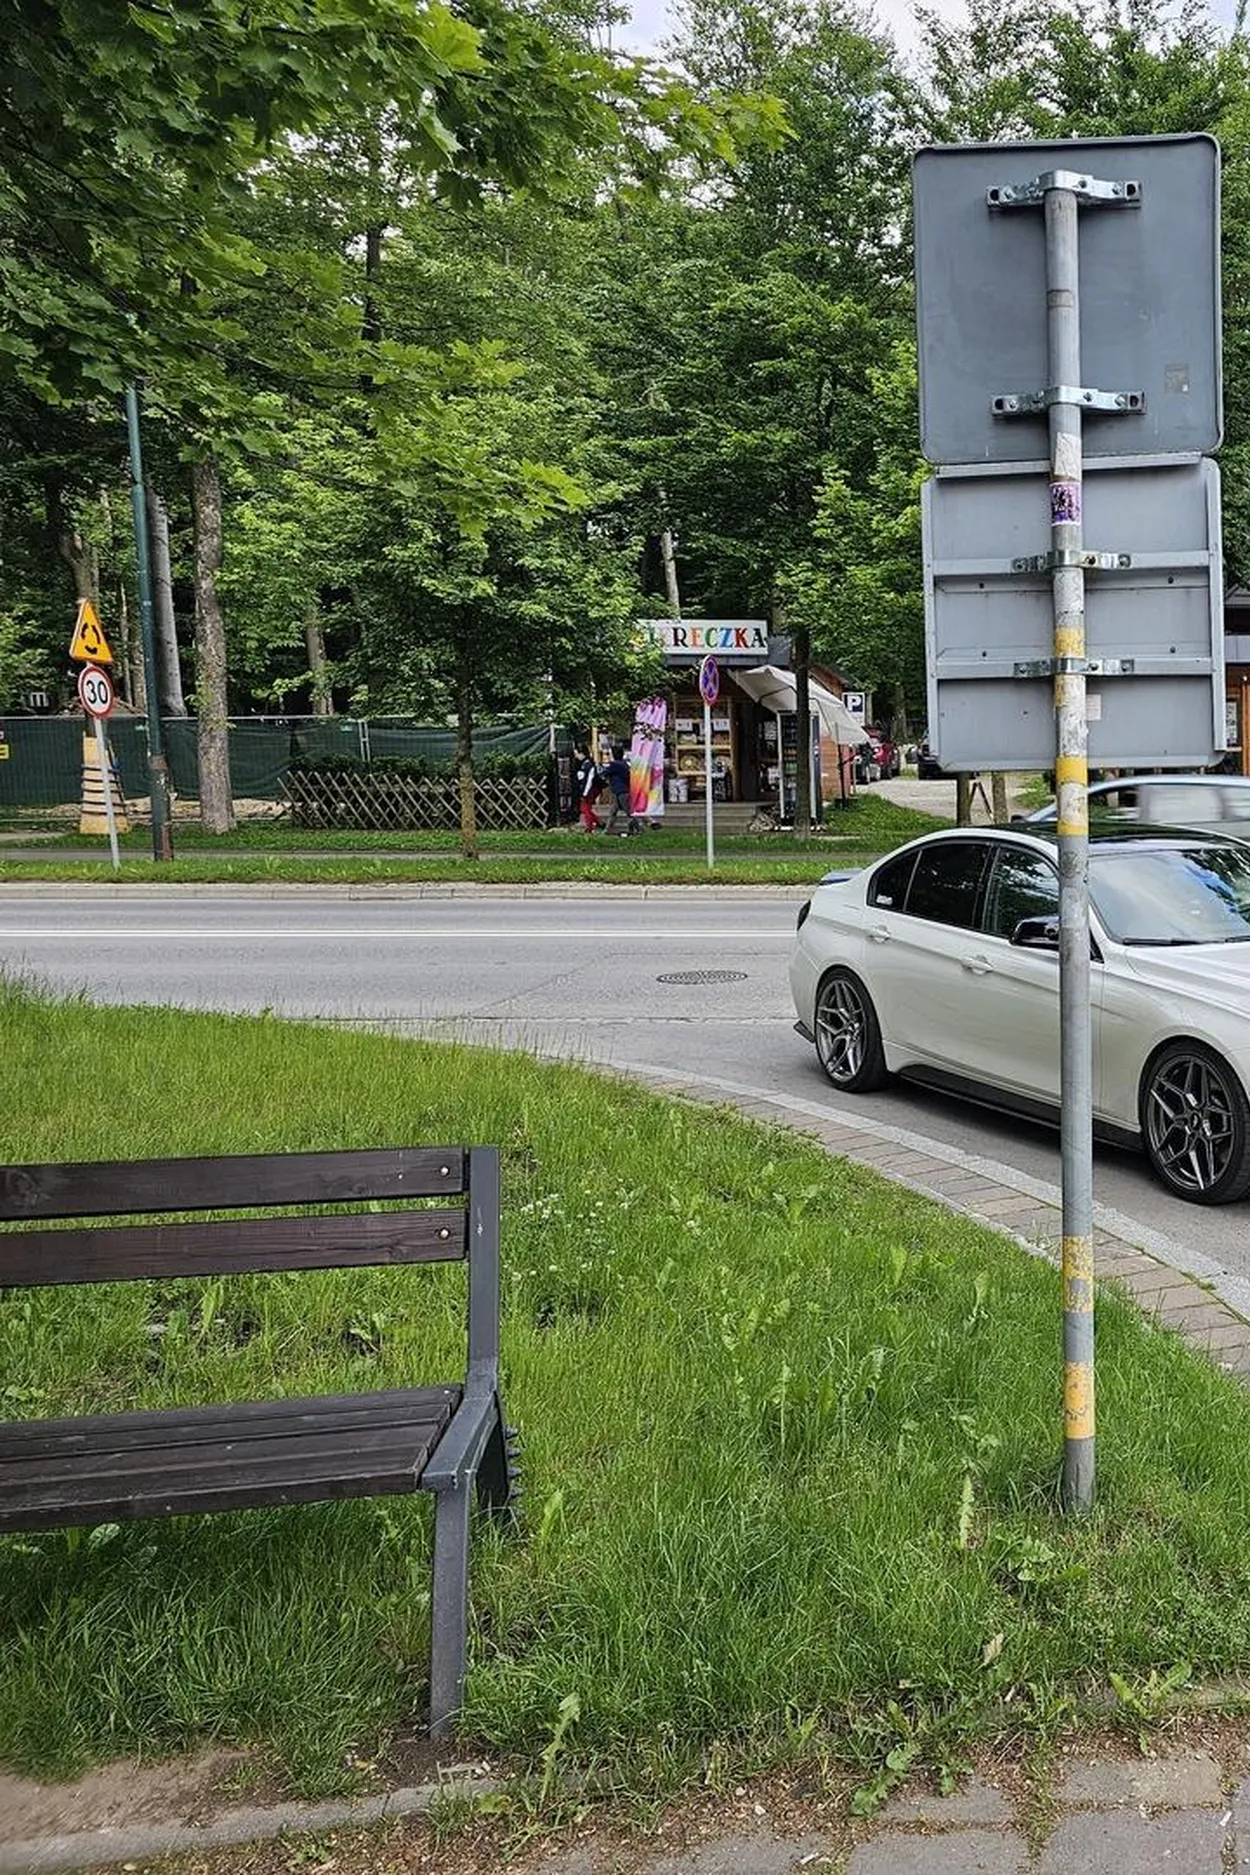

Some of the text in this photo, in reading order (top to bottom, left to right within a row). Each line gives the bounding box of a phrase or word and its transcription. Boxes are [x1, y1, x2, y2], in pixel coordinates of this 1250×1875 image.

[648, 624, 766, 649] RECZKA
[86, 680, 108, 704] 30
[847, 695, 861, 711] P
